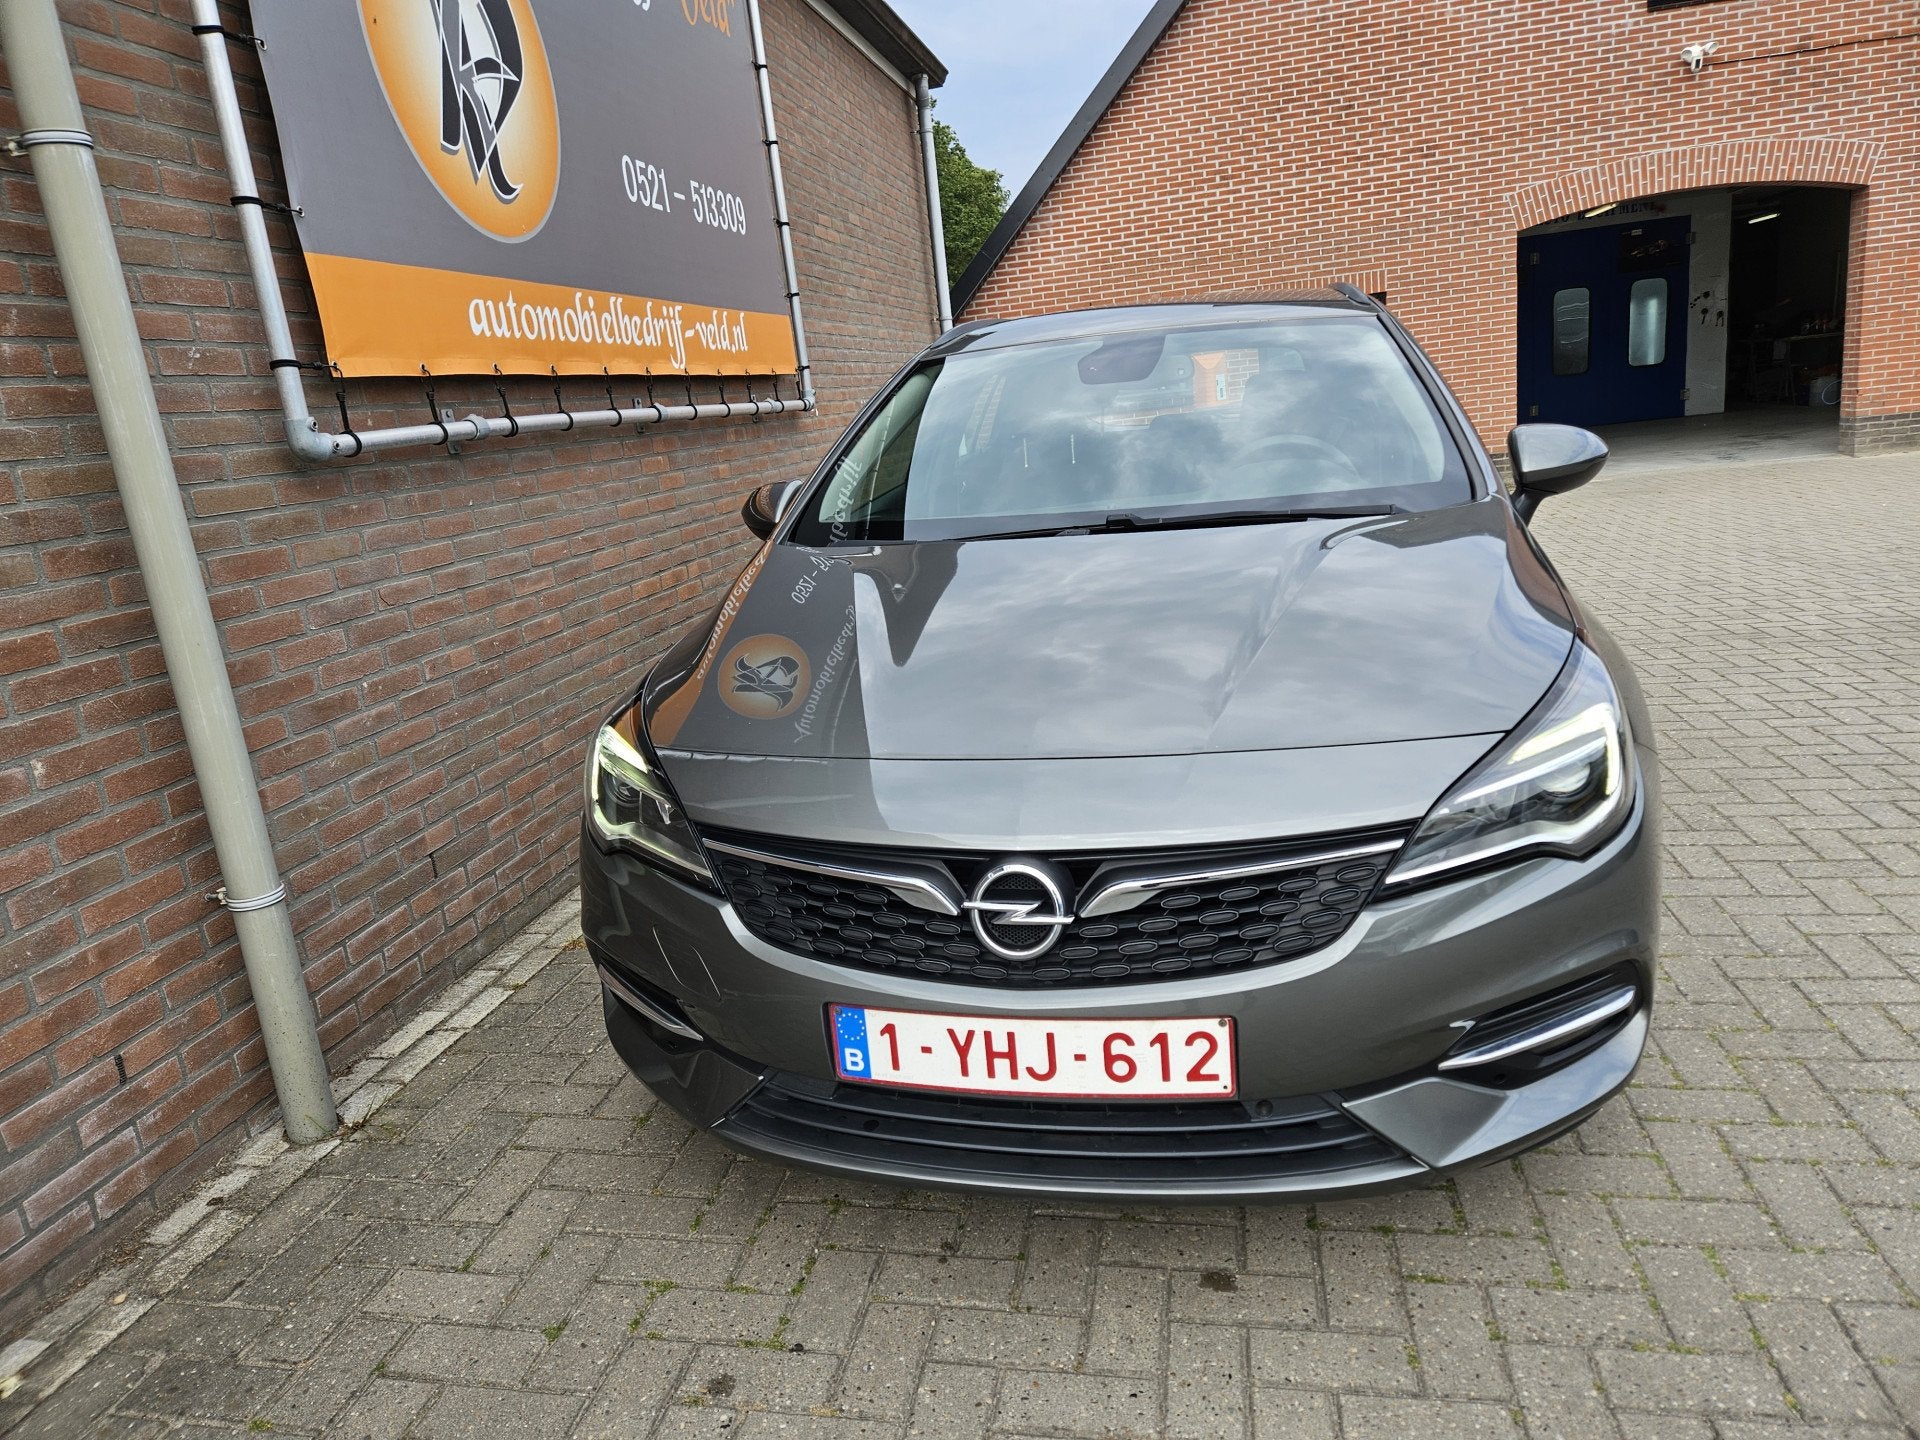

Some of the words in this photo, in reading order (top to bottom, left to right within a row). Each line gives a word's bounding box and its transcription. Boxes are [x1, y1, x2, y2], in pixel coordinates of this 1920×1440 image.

[621, 154, 671, 213] 0521
[690, 180, 747, 235] 513309
[468, 289, 749, 369] automobielbedrijf-veld.nl
[844, 1047, 865, 1071] B
[880, 1022, 1220, 1083] 1-YHJ-612
